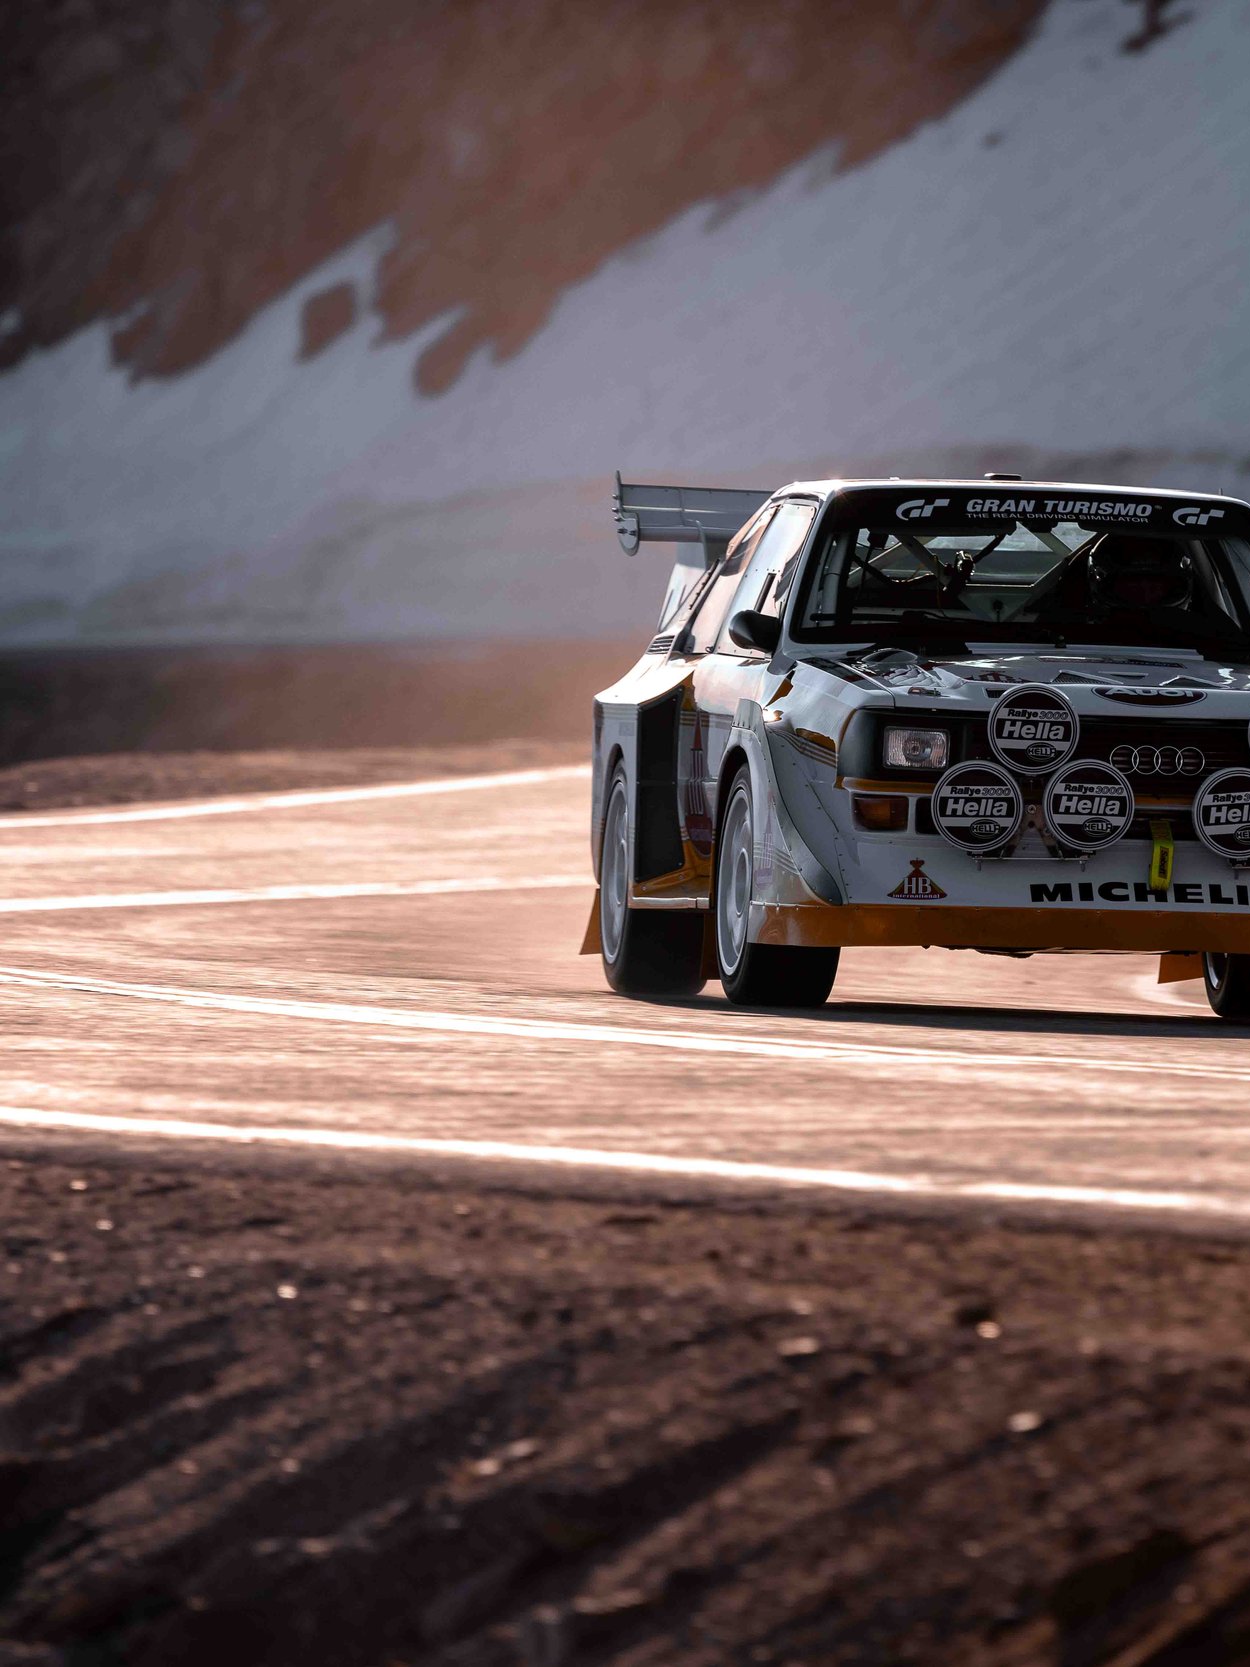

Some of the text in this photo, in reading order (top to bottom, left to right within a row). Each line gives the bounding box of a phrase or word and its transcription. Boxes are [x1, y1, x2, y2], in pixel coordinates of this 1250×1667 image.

[966, 499, 1036, 513] GRAN
[1044, 500, 1153, 517] TURISMO
[1027, 513, 1078, 521] DRIVING
[1079, 515, 1149, 523] SIMULATOR
[1008, 709, 1069, 720] Rallye 3000
[1002, 721, 1065, 740] Hella
[950, 787, 1011, 796] Rallye 3000
[1064, 784, 1124, 795] Rallye 3000
[1059, 796, 1120, 815] Hella
[1212, 794, 1243, 803] Rallye
[946, 799, 1008, 816] Hella
[903, 877, 932, 894] HB
